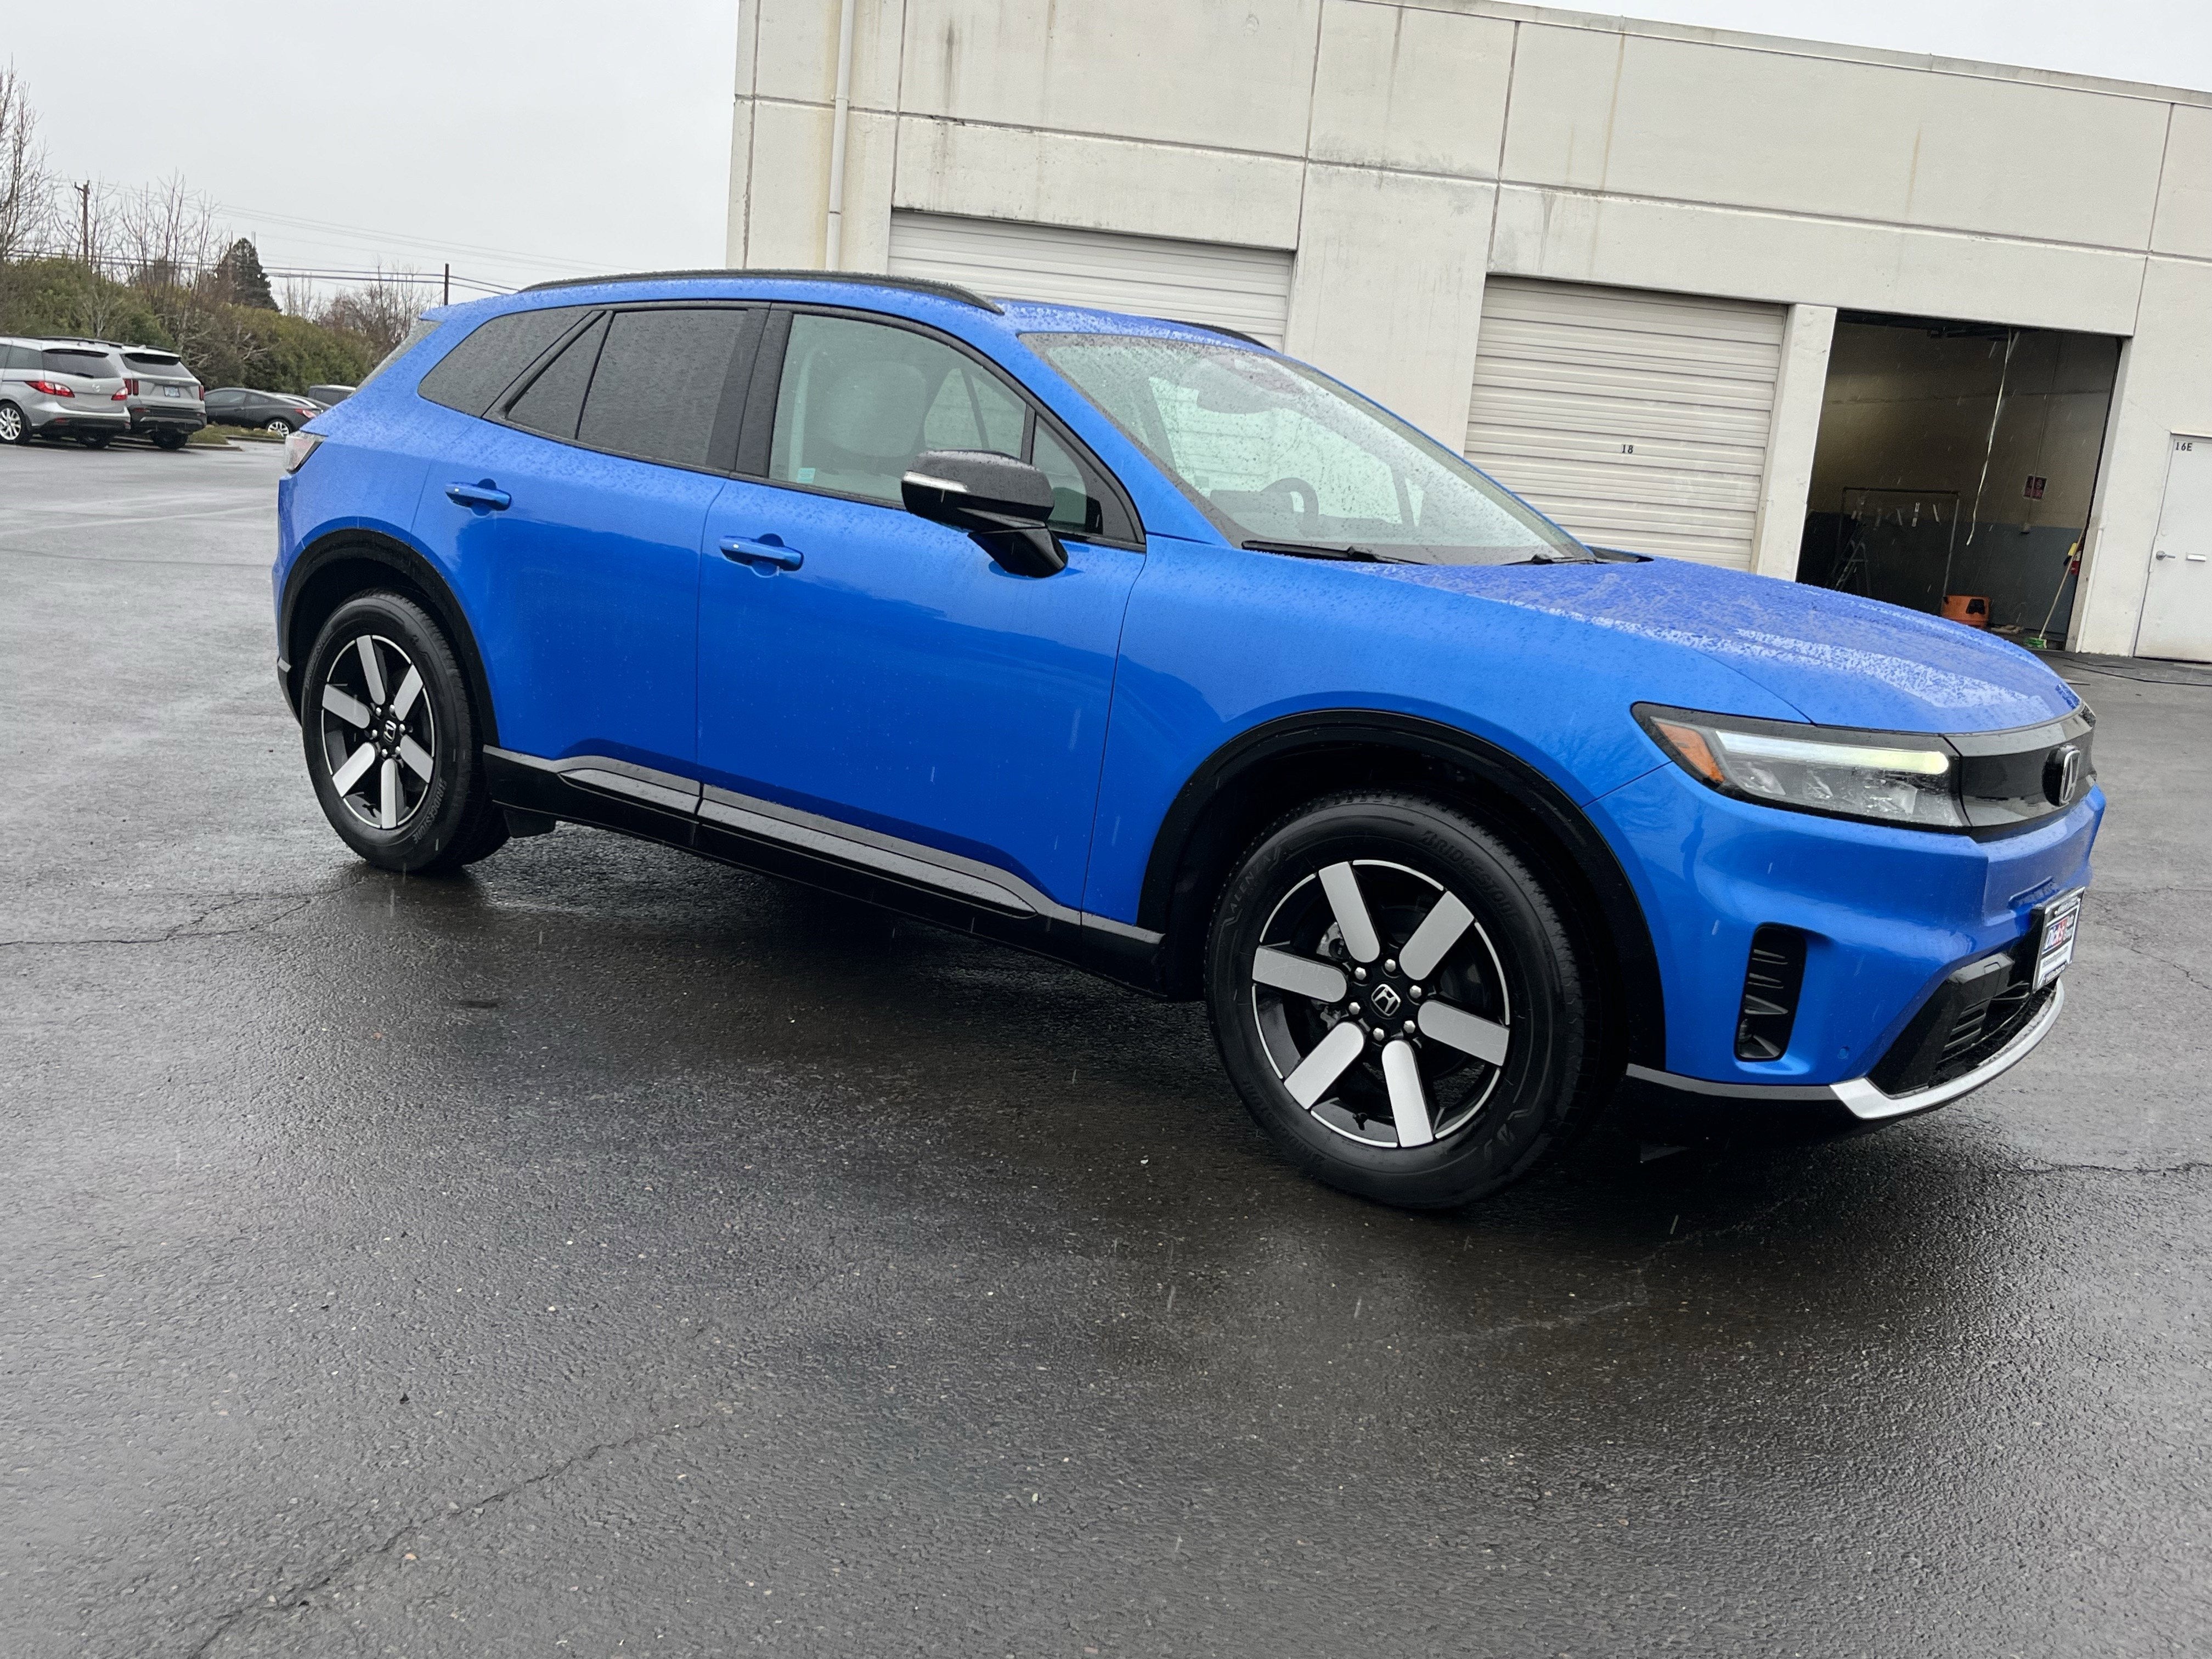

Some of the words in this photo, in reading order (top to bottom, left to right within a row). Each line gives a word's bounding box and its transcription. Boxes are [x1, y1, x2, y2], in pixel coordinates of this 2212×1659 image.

[1622, 444, 1633, 454] 18
[2176, 442, 2193, 452] 16E
[1227, 852, 1272, 914] ALENZA
